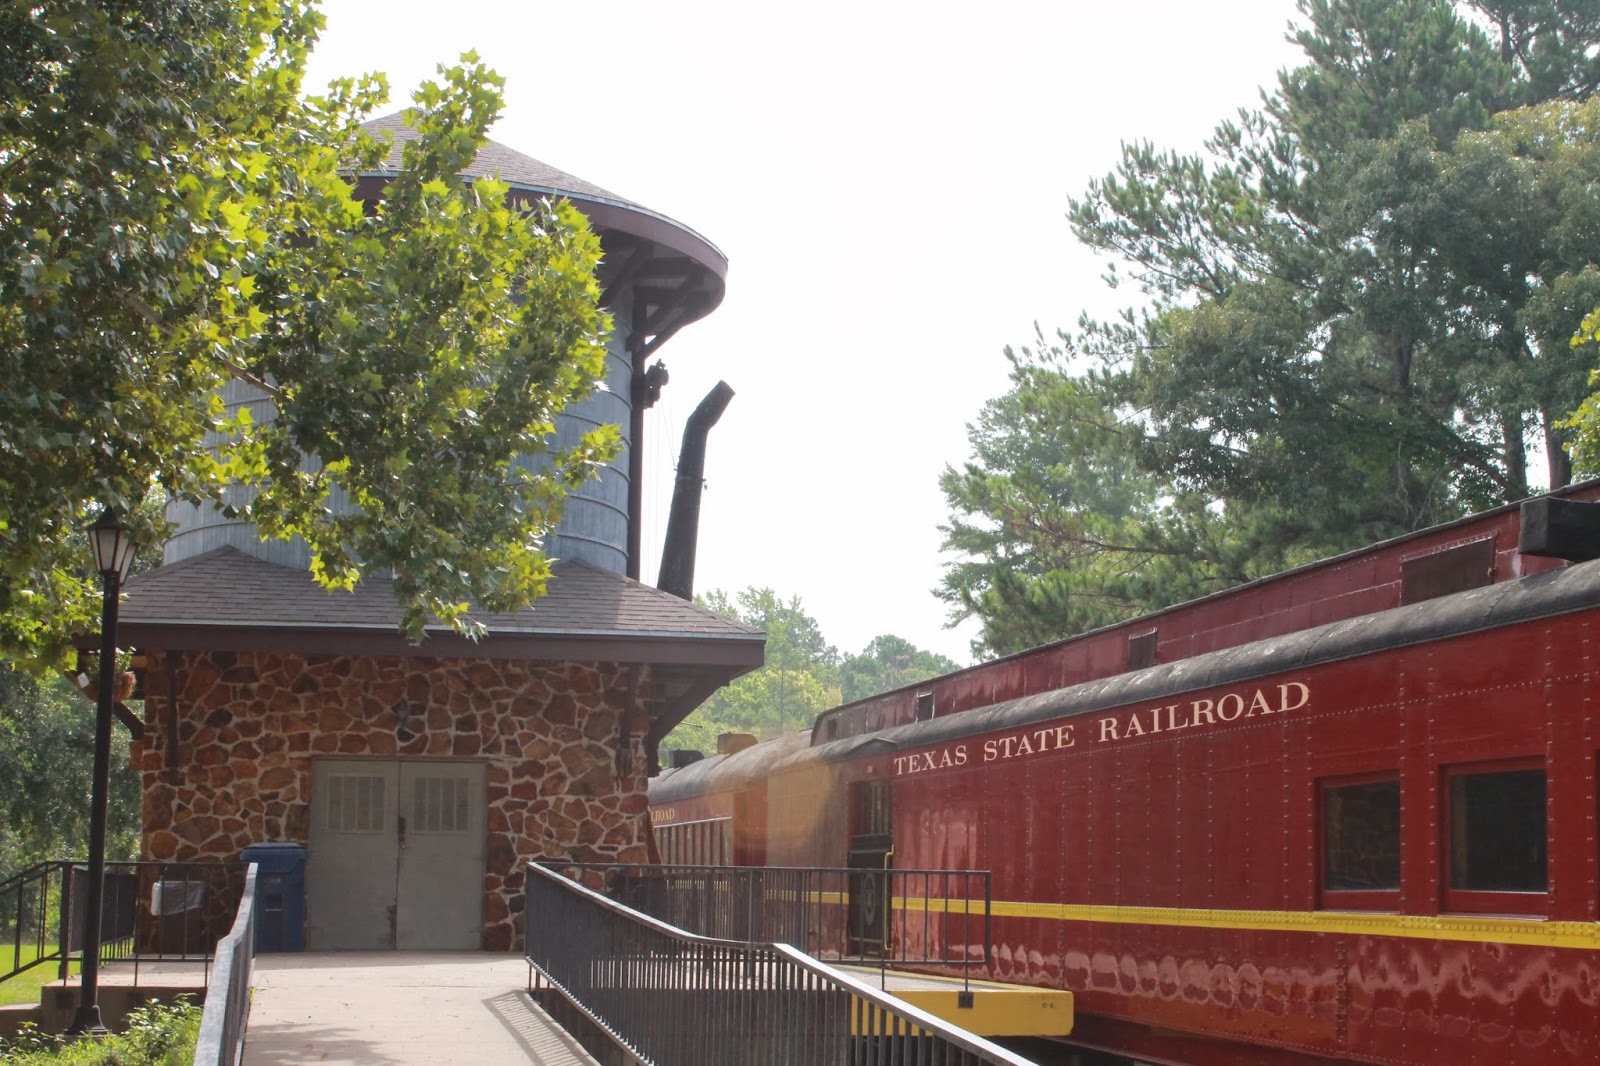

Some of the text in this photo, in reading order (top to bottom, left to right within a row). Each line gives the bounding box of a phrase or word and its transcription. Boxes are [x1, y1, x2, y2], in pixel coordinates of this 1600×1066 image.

[894, 682, 1311, 775] TEXAS STATE RAILROAD
